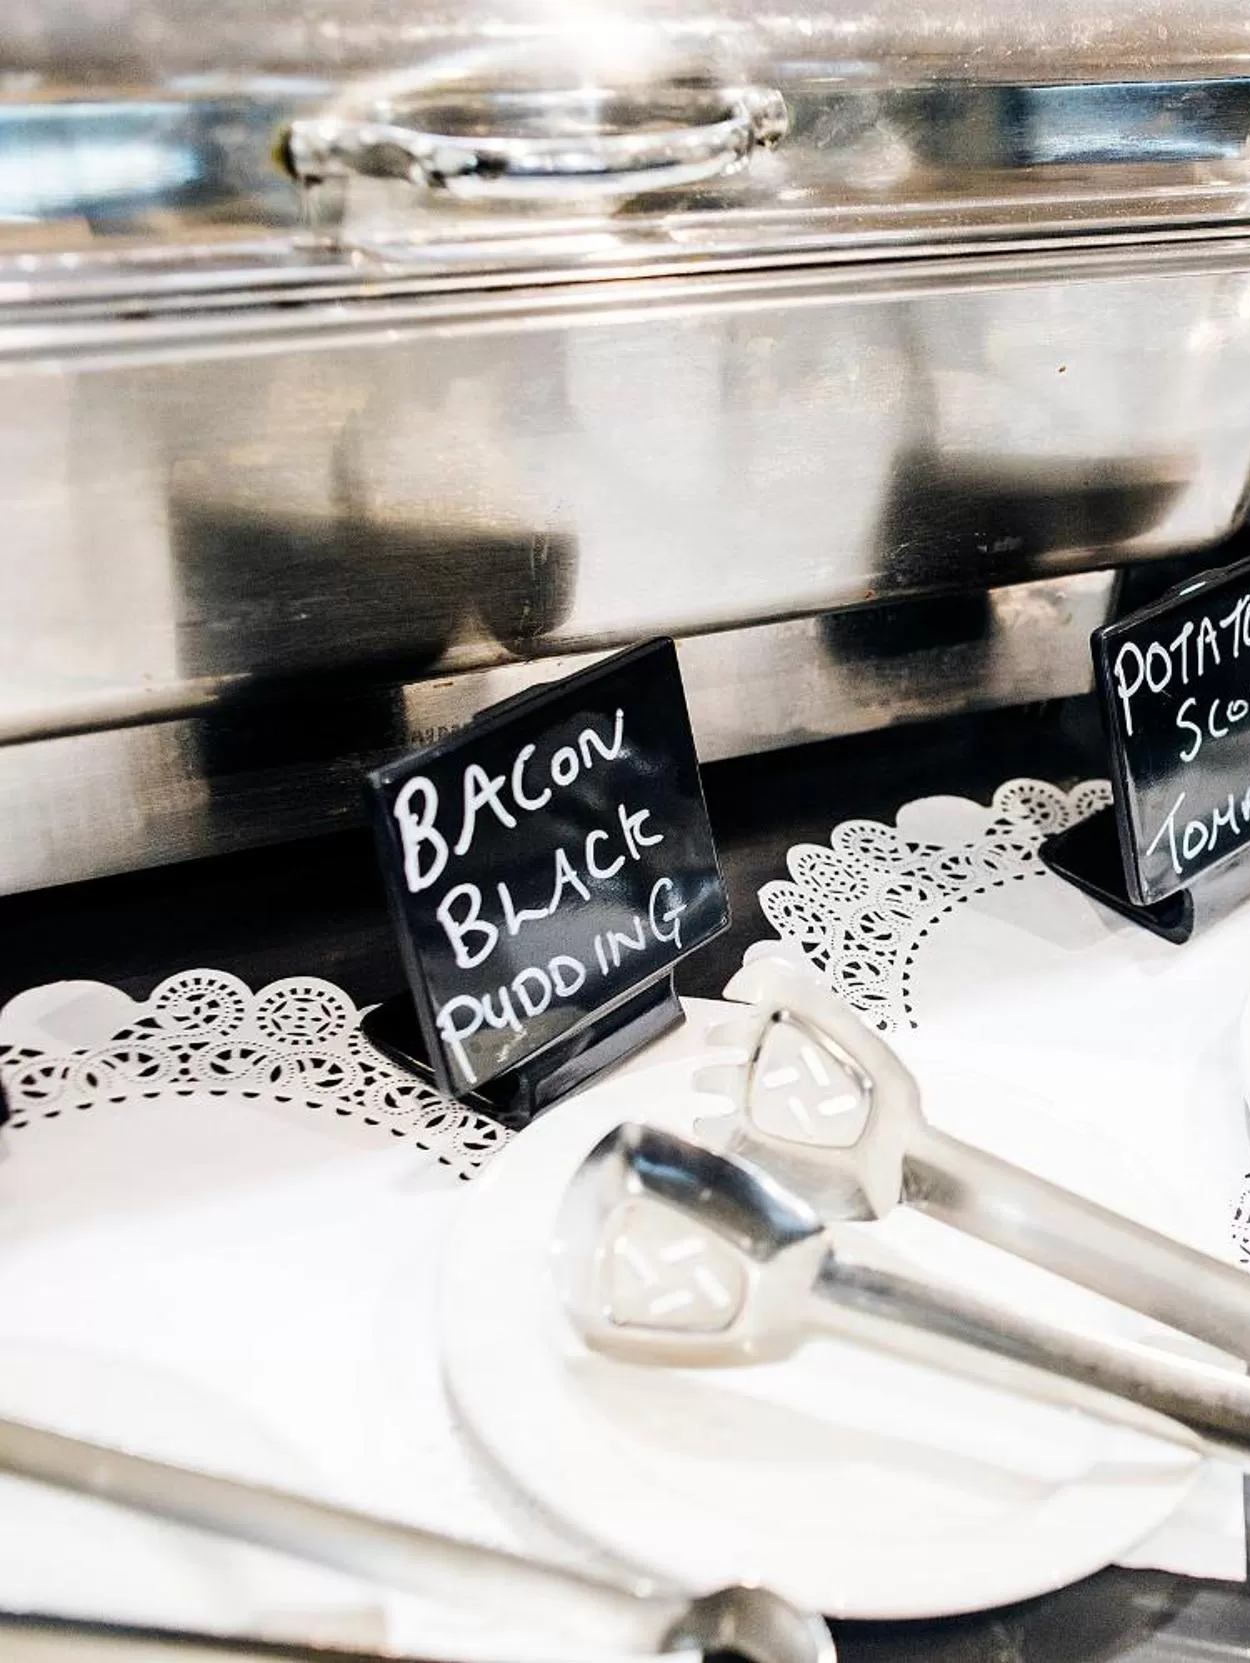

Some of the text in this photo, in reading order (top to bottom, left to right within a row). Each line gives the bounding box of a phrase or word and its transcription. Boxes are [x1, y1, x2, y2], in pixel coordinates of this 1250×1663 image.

[393, 708, 625, 893] BACON
[437, 803, 664, 969] BLACK
[436, 876, 688, 1084] PUDDING
